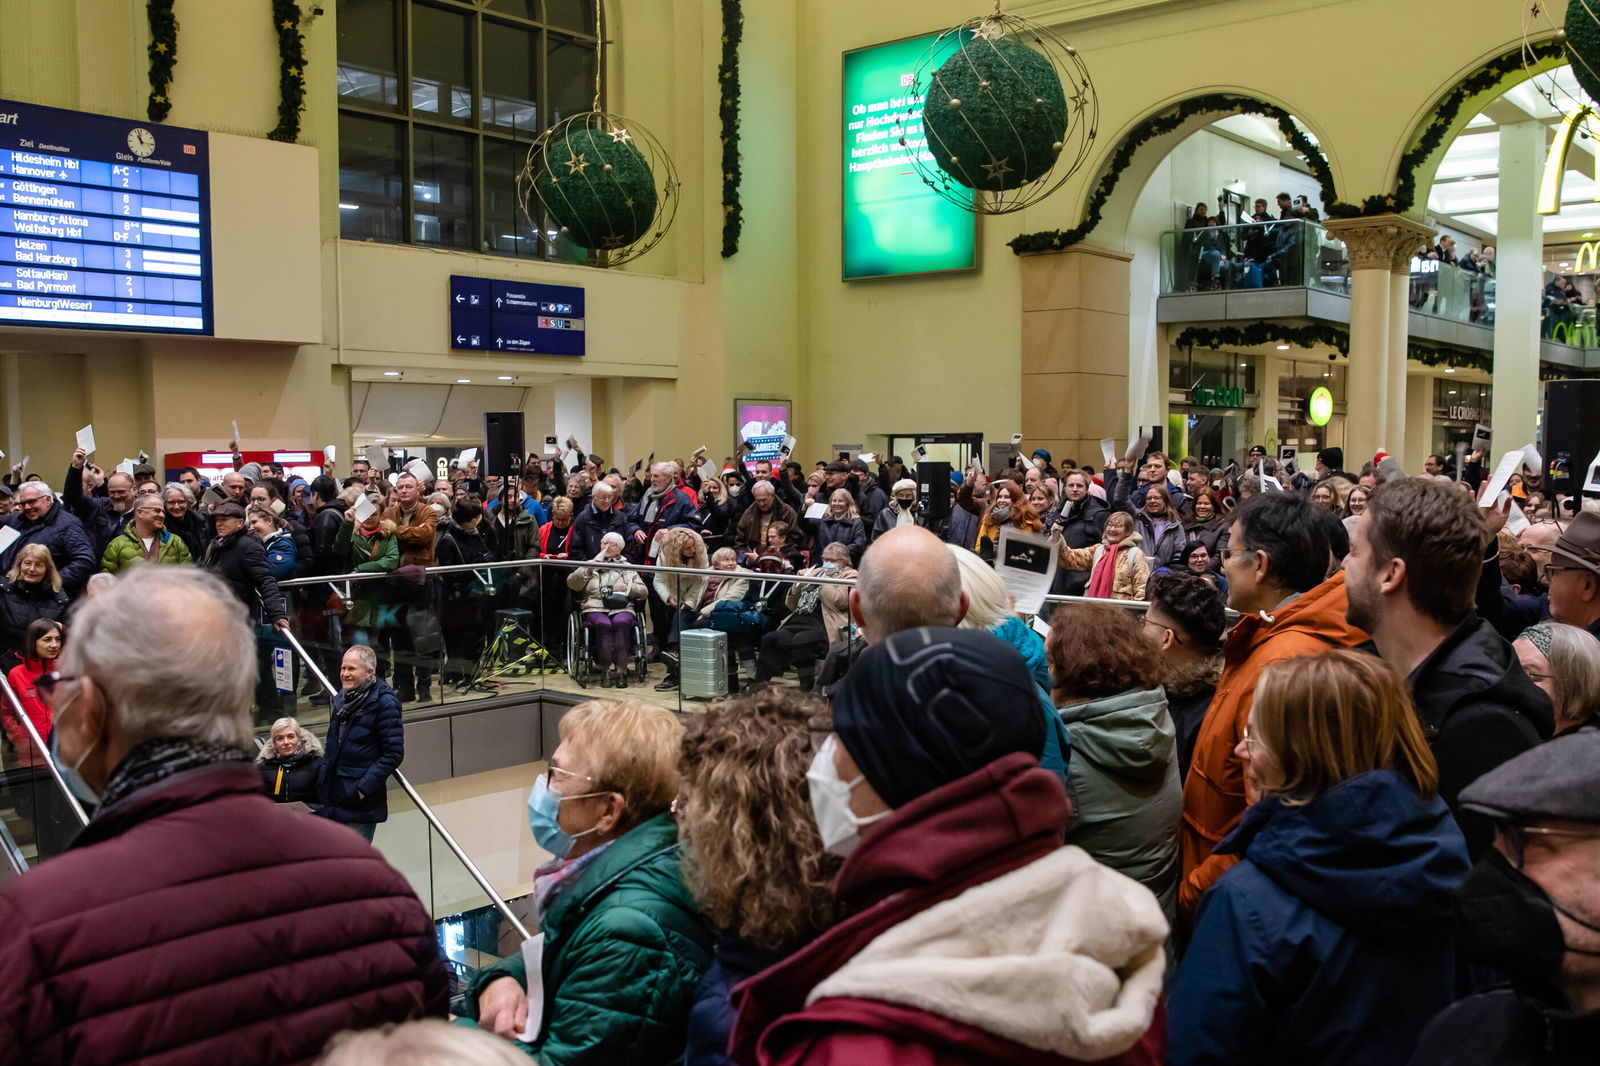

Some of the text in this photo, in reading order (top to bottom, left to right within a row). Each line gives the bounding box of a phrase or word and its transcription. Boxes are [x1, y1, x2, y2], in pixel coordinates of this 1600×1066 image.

[852, 104, 867, 115] Ob
[868, 102, 888, 113] man
[890, 96, 906, 108] bei
[848, 108, 924, 130] nur Hochdeutsc
[856, 132, 888, 143] Finden
[890, 126, 904, 137] Sie
[906, 124, 918, 134] es
[20, 138, 70, 152] Ziel Destination
[852, 143, 889, 158] herzlich
[12, 152, 80, 170] Hildesheim Hbf
[116, 152, 134, 161] Gleis
[12, 164, 56, 178] Hannover
[112, 166, 130, 176] A-C
[12, 182, 58, 196] Göttingen
[122, 178, 129, 187] 2
[13, 194, 75, 208] Bennemühlen
[123, 195, 129, 203] 8
[124, 206, 130, 215] 2
[14, 210, 88, 226] Hamburg-Altona
[14, 222, 82, 238] Wolfsburg Hbf
[124, 222, 130, 230] 8
[114, 232, 140, 243] D-F 1
[15, 239, 47, 251] Uelzen
[16, 251, 77, 267] Bad Harzburg
[125, 249, 131, 258] 3
[125, 261, 131, 269] 4
[16, 268, 68, 281] Soltau(Han)
[17, 280, 76, 293] Bad Pyrmont
[126, 277, 132, 286] 2
[128, 288, 133, 296] 1
[17, 297, 93, 310] Nienburg(Weser)
[127, 304, 133, 313] 2
[550, 320, 555, 328] S
[1450, 406, 1457, 419] LE
